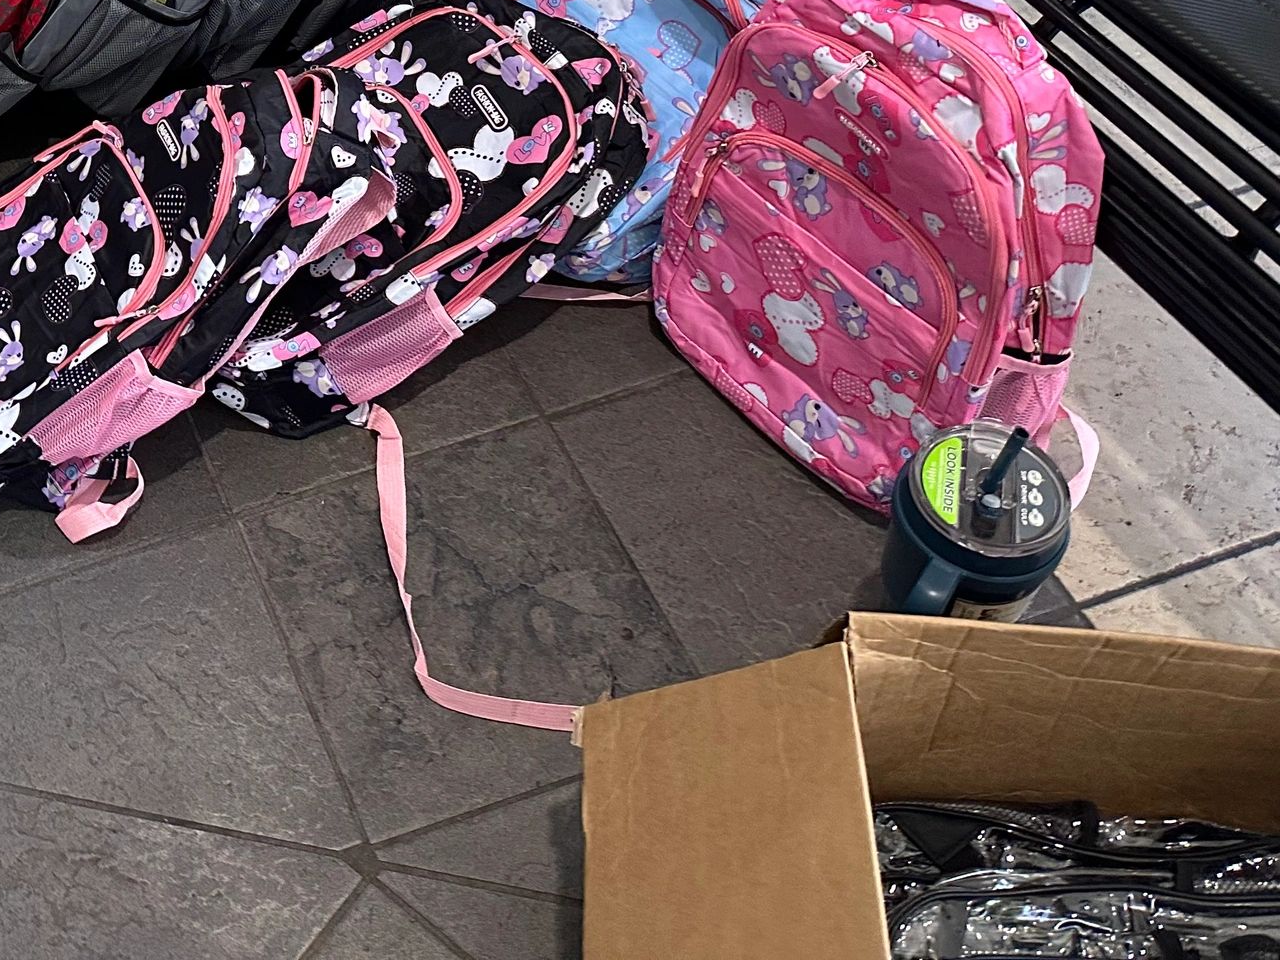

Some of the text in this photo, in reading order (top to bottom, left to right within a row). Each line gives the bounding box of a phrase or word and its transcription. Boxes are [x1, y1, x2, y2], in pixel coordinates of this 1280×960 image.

[475, 89, 505, 125] FASHION-BAG
[513, 121, 556, 162] LOVE
[943, 446, 957, 513] LOOK INSIDE
